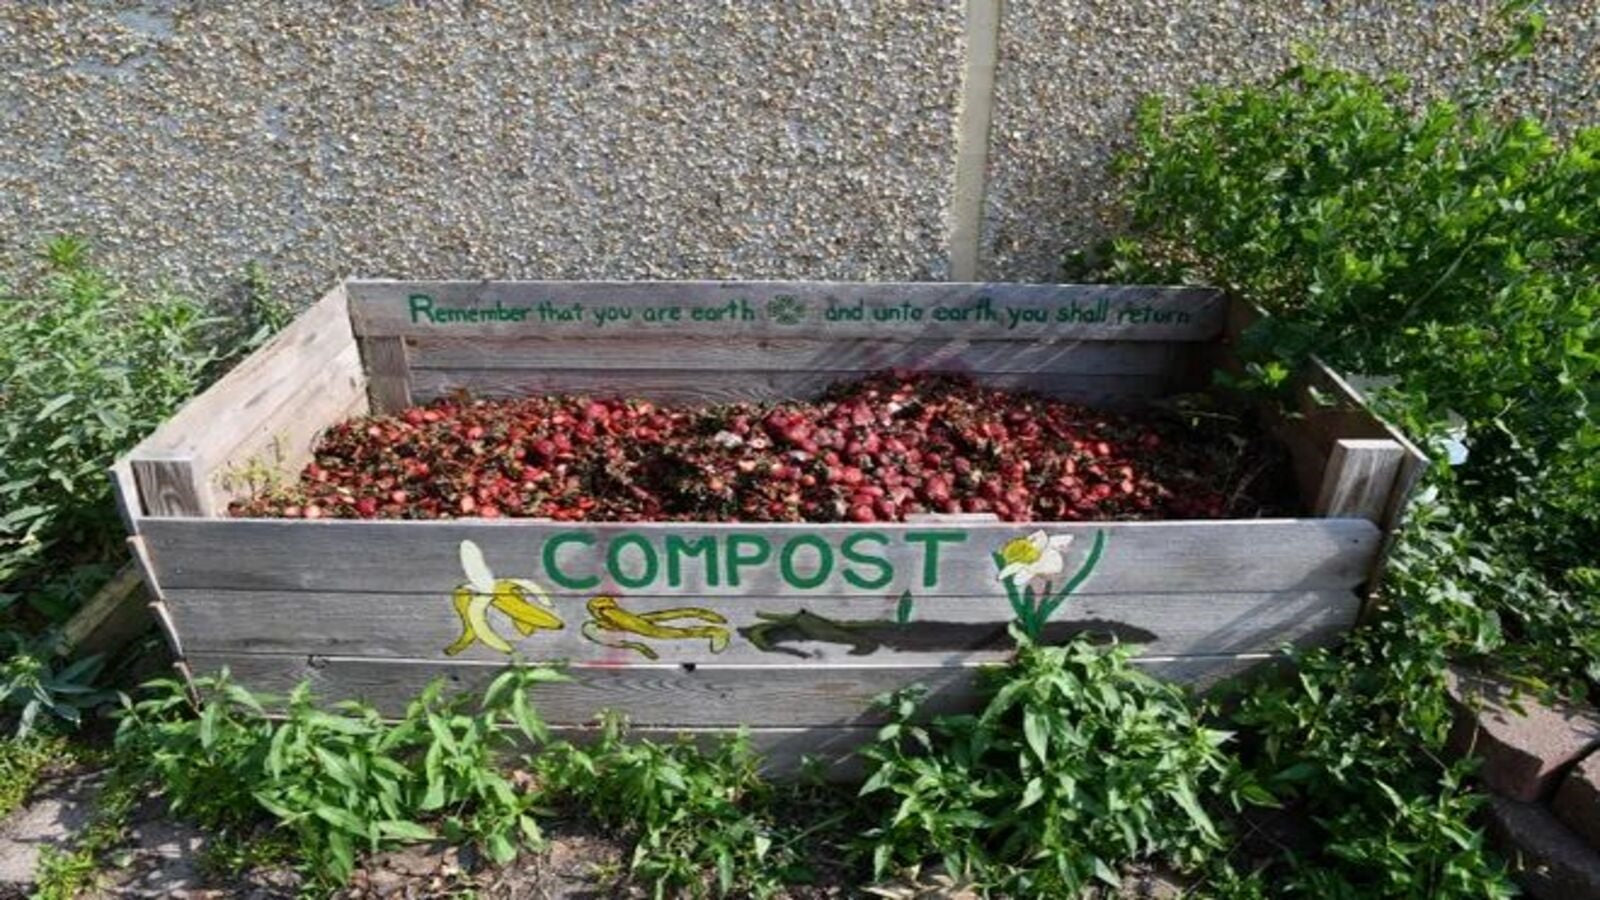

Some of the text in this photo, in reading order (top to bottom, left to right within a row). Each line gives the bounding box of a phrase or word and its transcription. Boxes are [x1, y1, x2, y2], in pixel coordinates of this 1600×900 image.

[408, 293, 530, 323] Remember
[539, 301, 583, 321] that
[592, 309, 633, 327] you
[642, 309, 681, 321] are
[691, 300, 755, 322] earth
[825, 297, 864, 321] and
[873, 302, 923, 321] unto
[1005, 305, 1048, 329] you
[1055, 298, 1109, 322] shall
[1117, 304, 1192, 324] return
[541, 531, 968, 590] COMPOST
